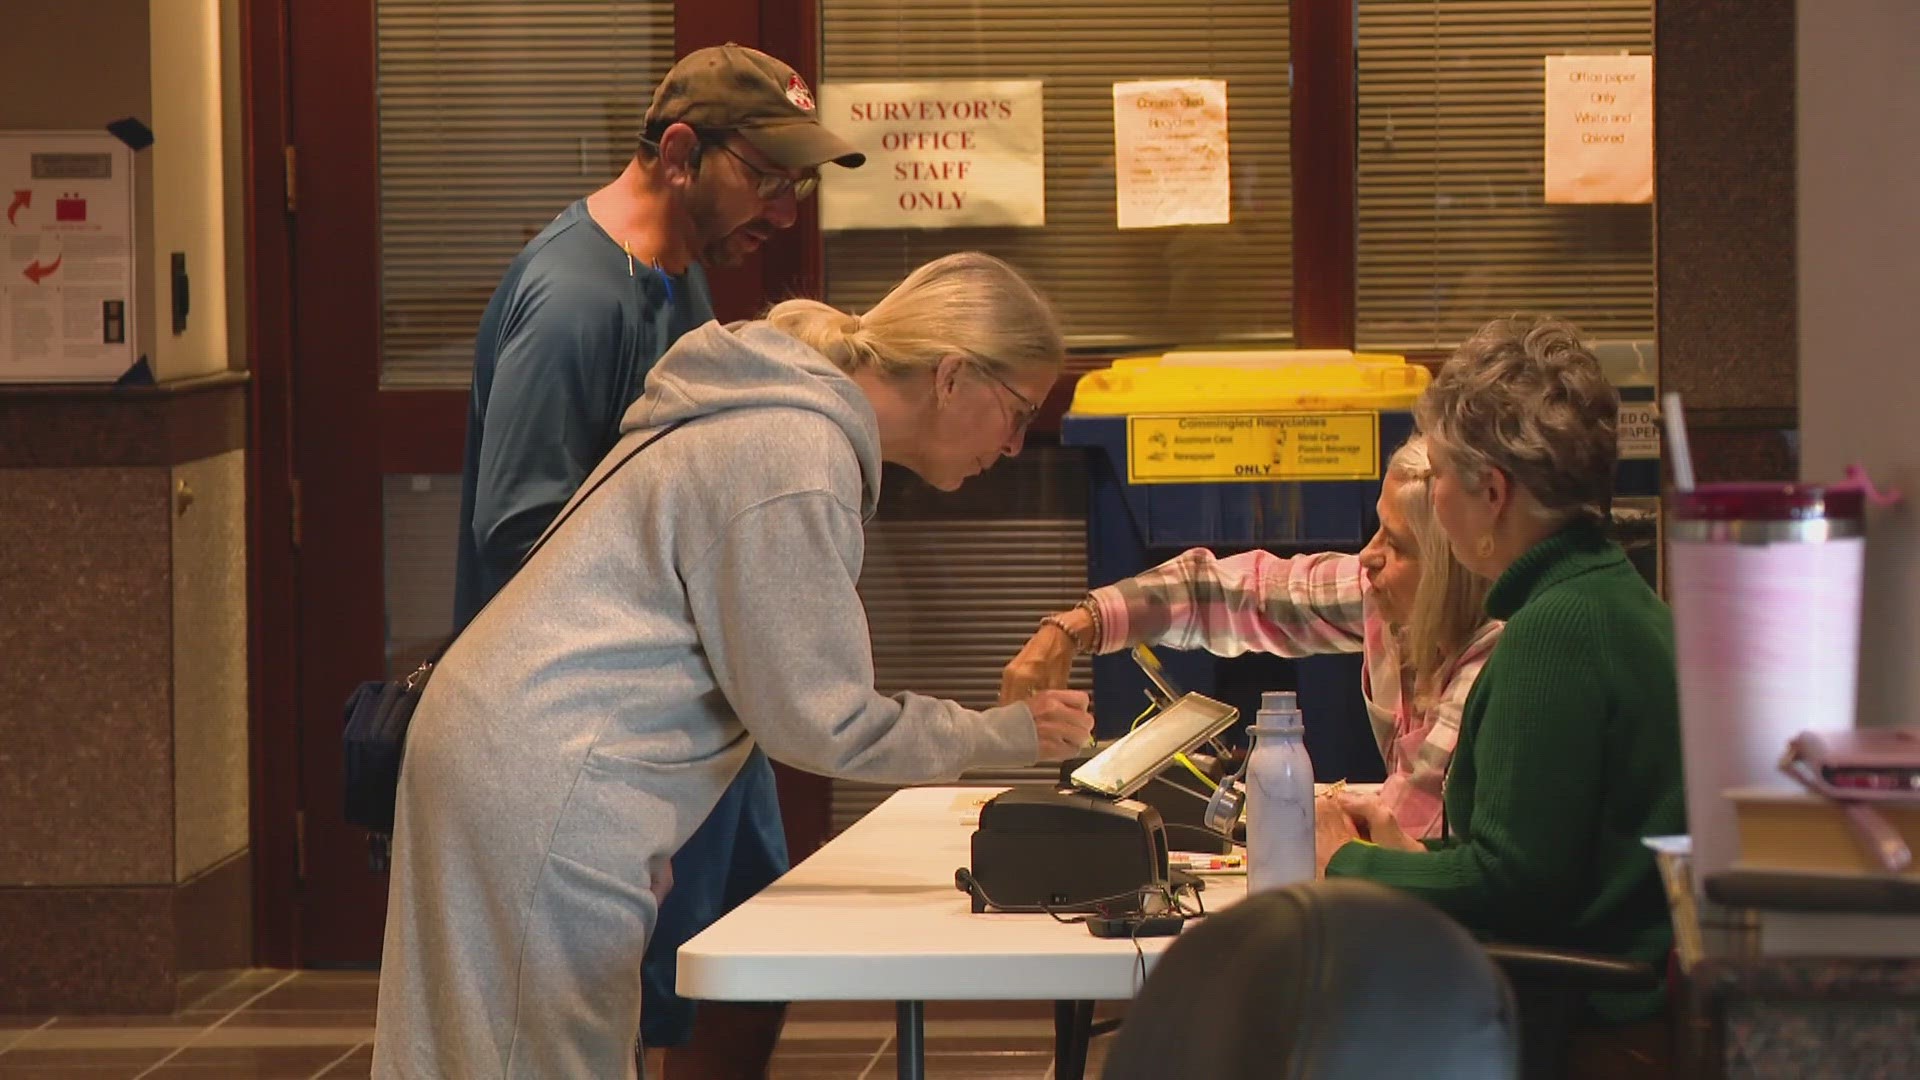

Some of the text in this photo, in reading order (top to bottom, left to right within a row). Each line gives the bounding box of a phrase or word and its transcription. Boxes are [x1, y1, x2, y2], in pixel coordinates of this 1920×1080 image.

[1570, 71, 1636, 85] Office paper
[1590, 91, 1616, 105] Only
[851, 101, 1012, 121] SURVEYOR'S
[1574, 112, 1632, 124] White and
[882, 131, 976, 151] OFFICE
[1581, 133, 1625, 144] Colored
[895, 161, 972, 181] STAFF
[899, 191, 967, 210] ONLY
[1178, 416, 1327, 430] Commingled Recyclables
[1235, 464, 1271, 476] ONLY
